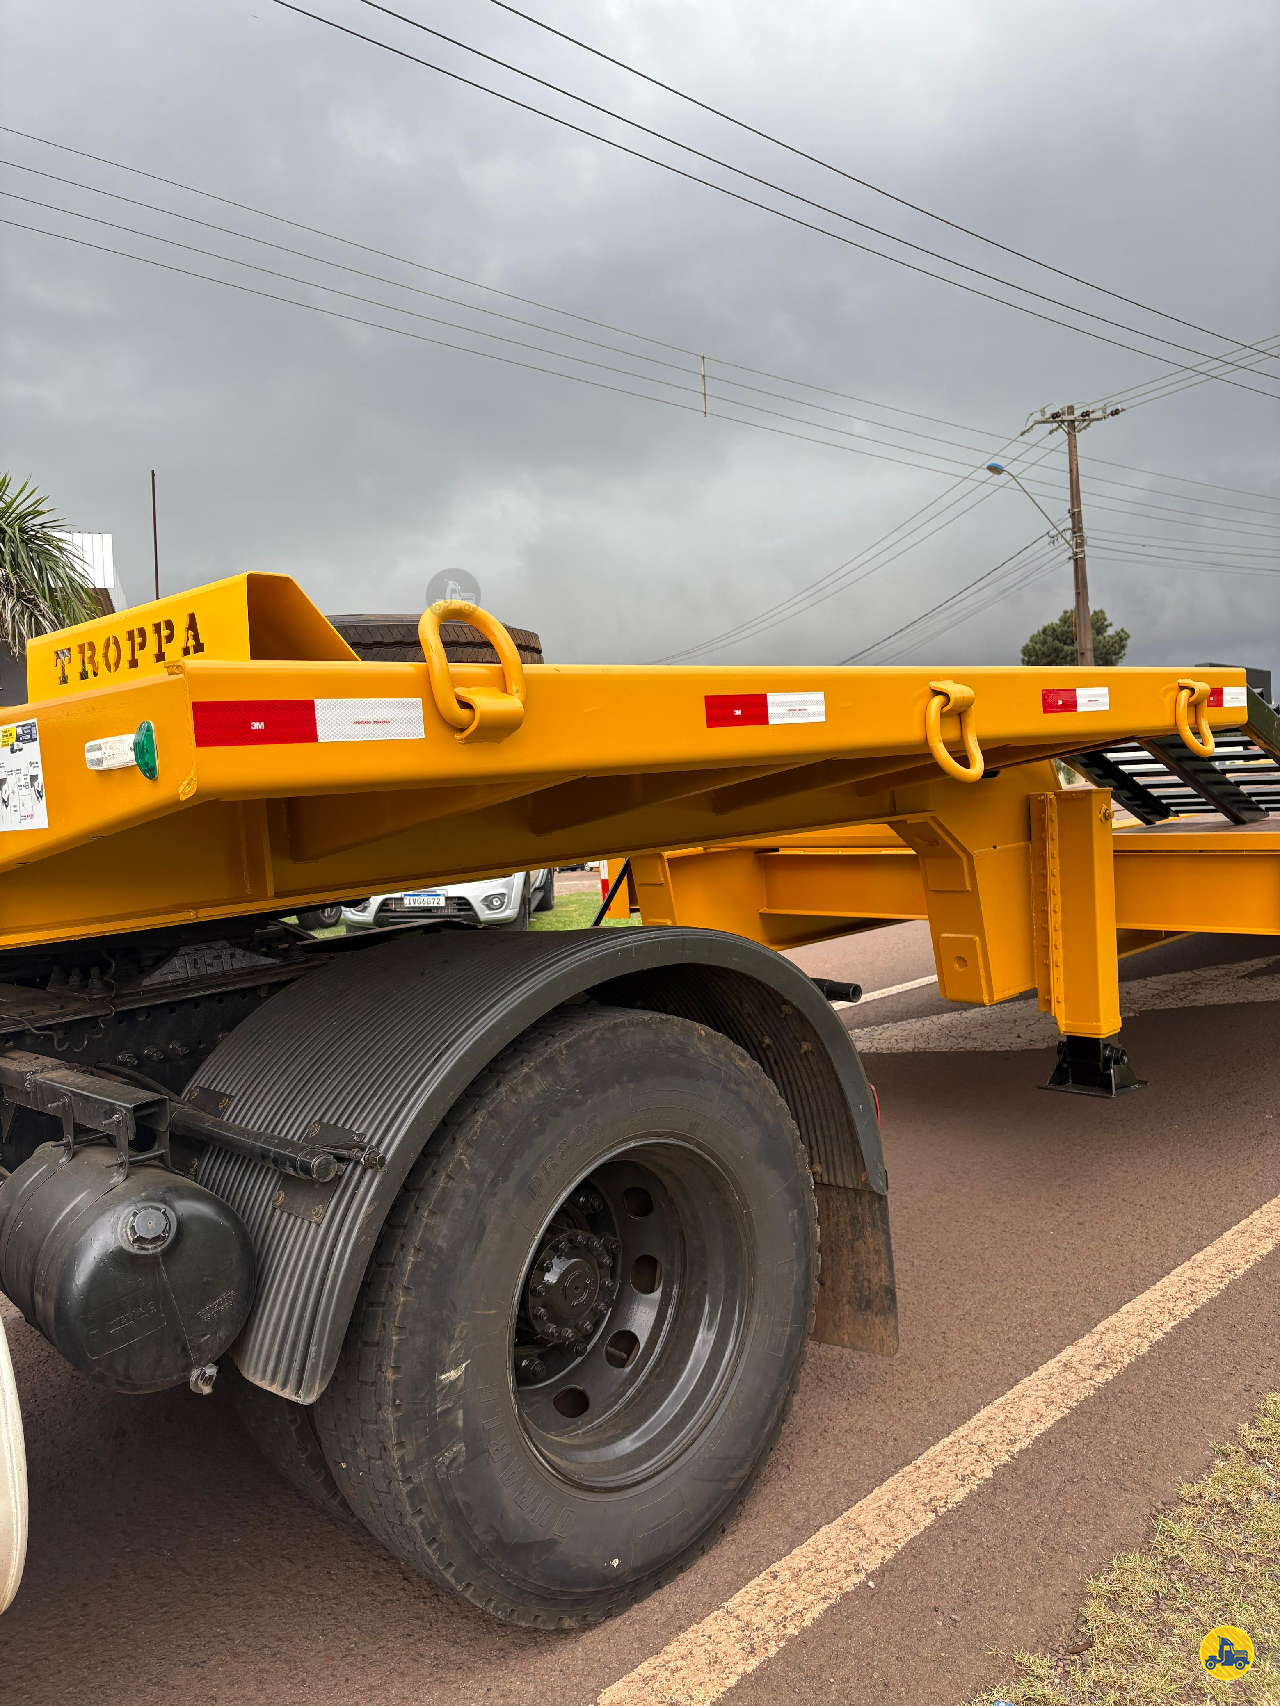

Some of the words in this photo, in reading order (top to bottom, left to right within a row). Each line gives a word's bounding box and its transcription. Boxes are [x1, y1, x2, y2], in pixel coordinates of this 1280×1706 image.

[53, 611, 205, 685] TROPPA
[250, 721, 265, 730] 3M
[477, 1382, 578, 1539] DURABLE
